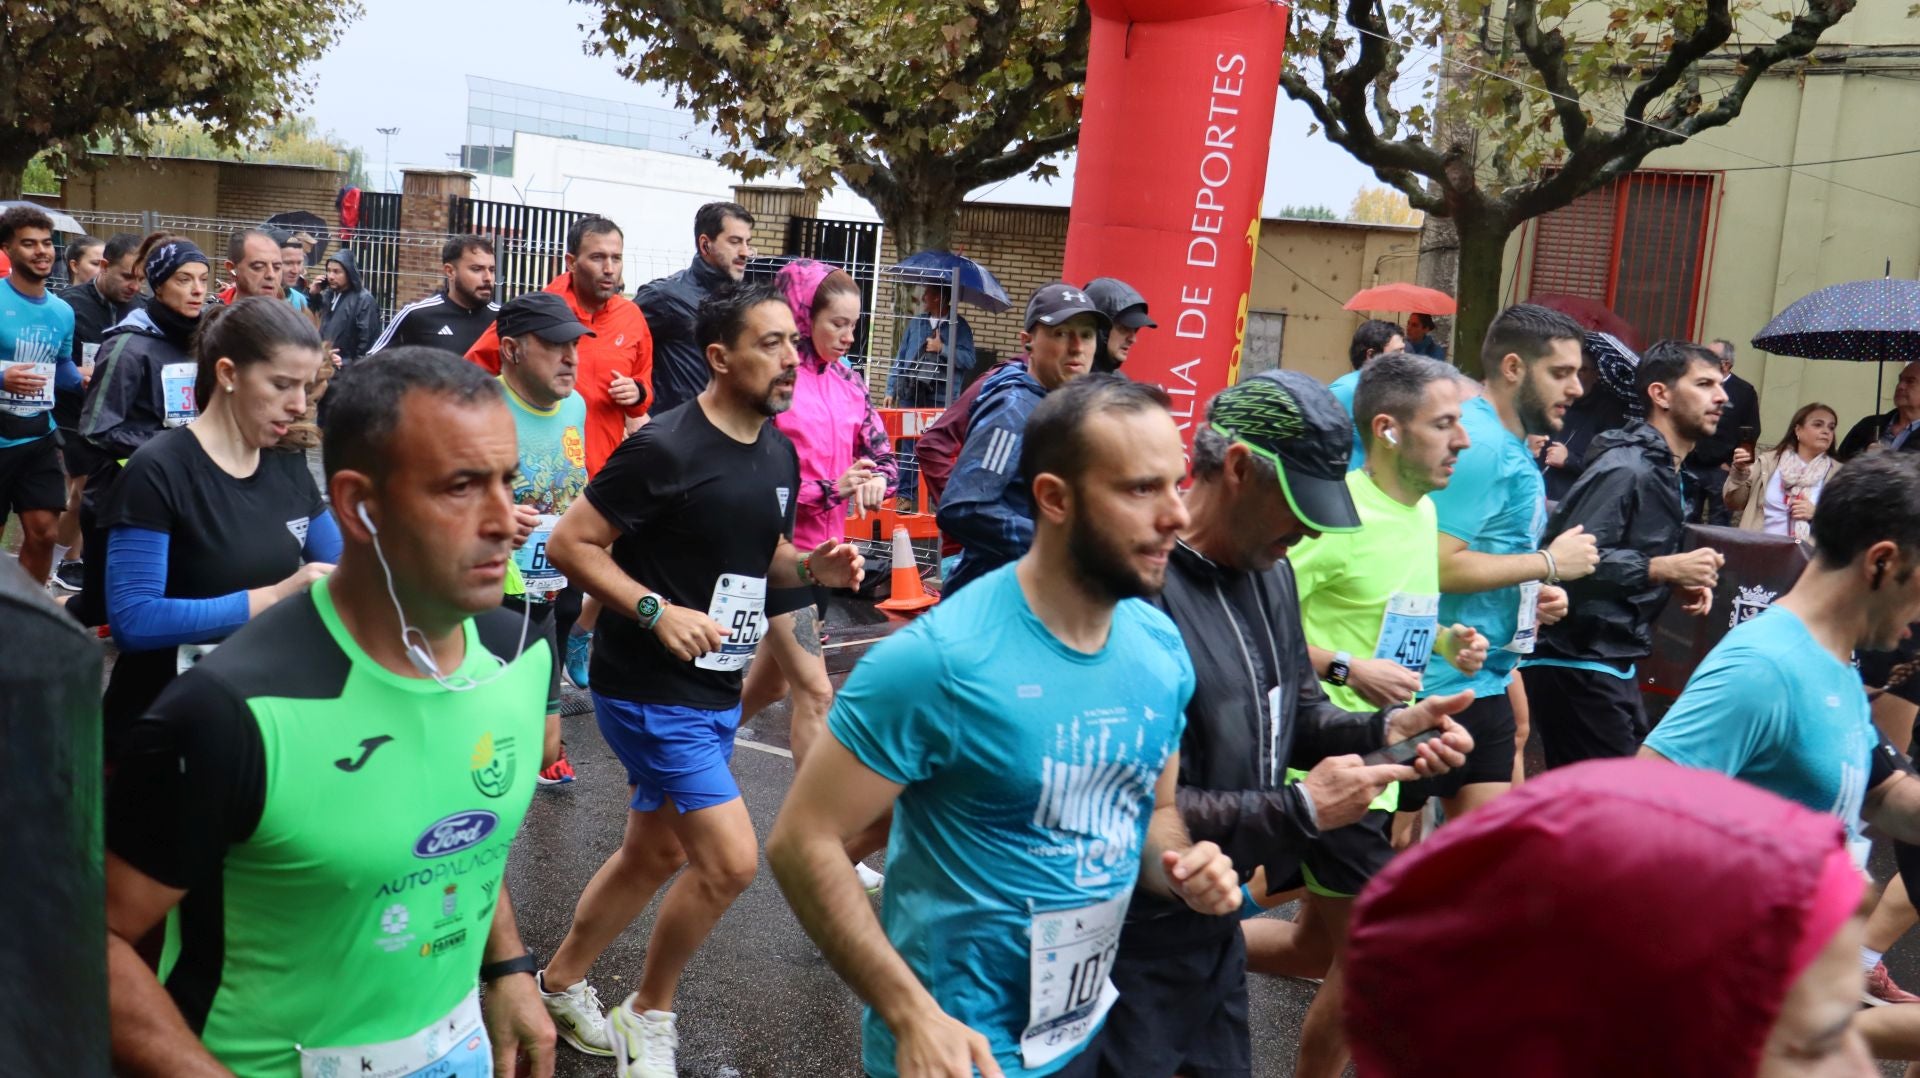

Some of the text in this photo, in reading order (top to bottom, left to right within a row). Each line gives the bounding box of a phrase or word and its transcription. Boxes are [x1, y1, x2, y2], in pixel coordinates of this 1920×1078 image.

[1187, 53, 1247, 268] DEPORTES
[1176, 286, 1212, 339] DE
[1394, 629, 1430, 664] 450
[427, 817, 484, 853] Ford
